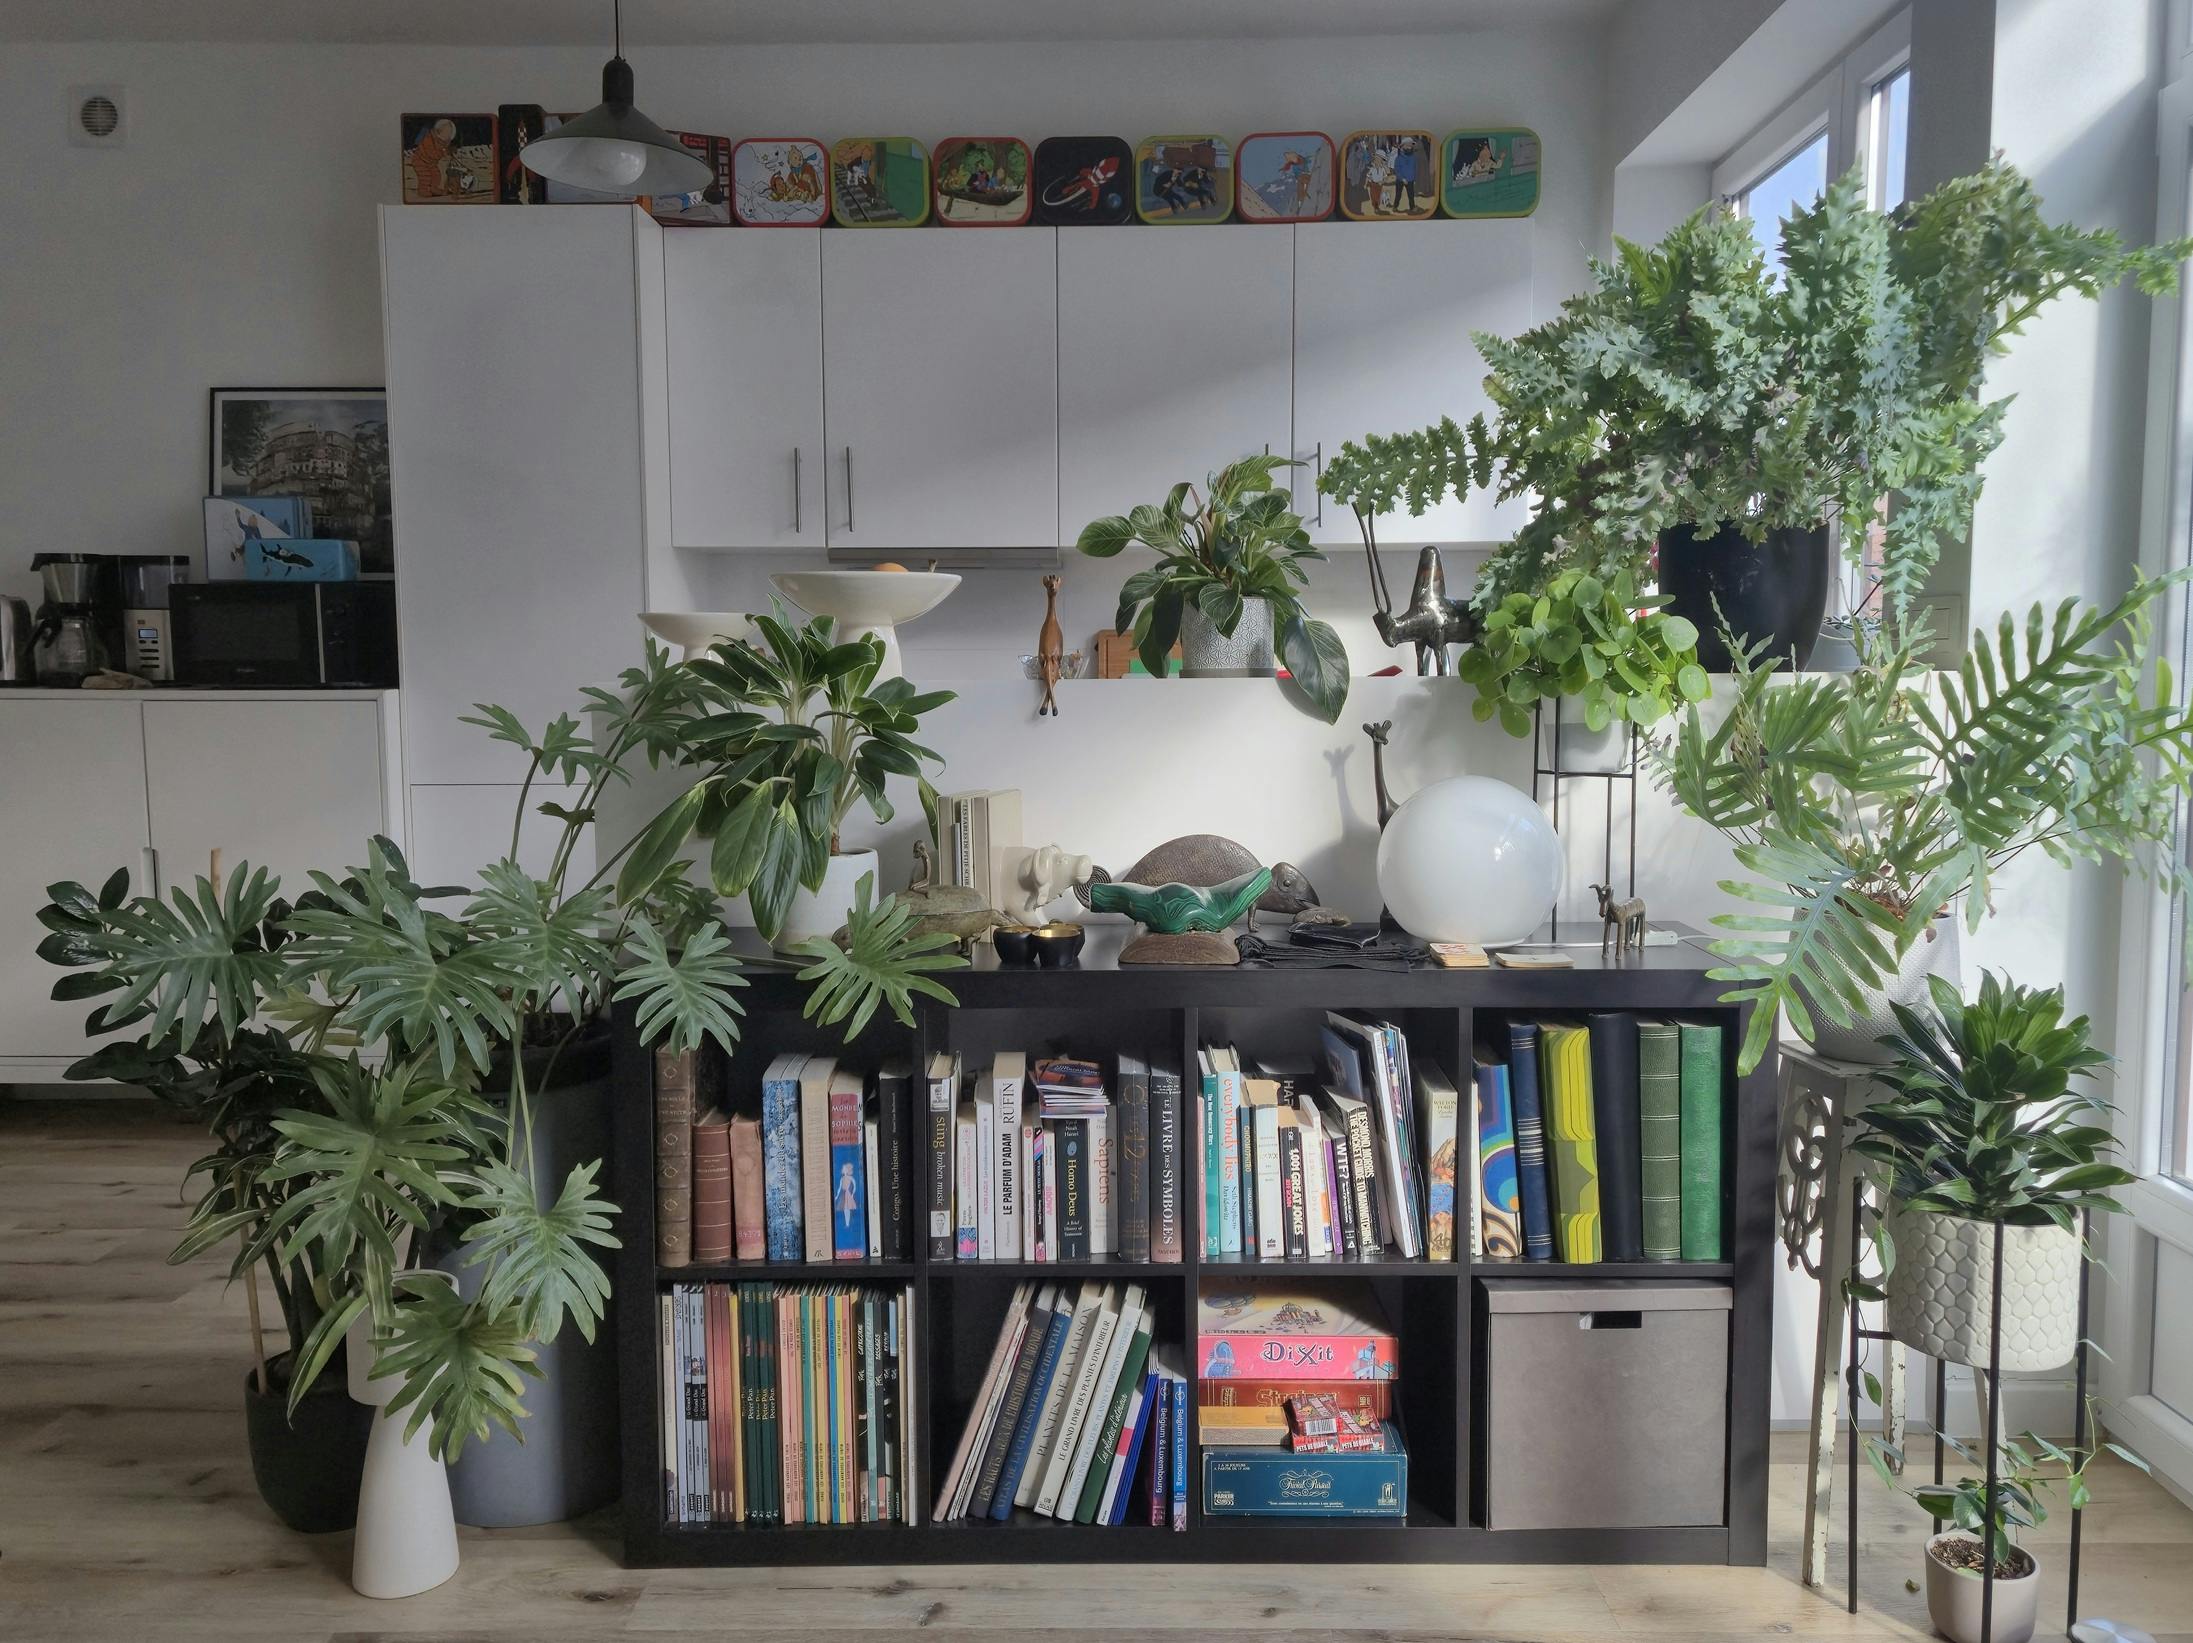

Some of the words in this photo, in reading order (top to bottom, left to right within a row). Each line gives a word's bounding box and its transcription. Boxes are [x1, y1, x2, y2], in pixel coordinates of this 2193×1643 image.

[1003, 1082, 1015, 1124] RUFIN
[1164, 1098, 1172, 1108] LE
[1221, 1078, 1239, 1151] everybody
[933, 1116, 945, 1149] sting
[1162, 1109, 1173, 1154] LIVRE
[1350, 1113, 1358, 1129] THE
[1358, 1111, 1371, 1148] DESMOND
[890, 1140, 899, 1170] histoire
[1002, 1133, 1012, 1166] D'ADAM
[1351, 1129, 1363, 1158] POCKET
[936, 1151, 944, 1180] broken
[1067, 1160, 1076, 1190] Homo
[1094, 1137, 1113, 1205] Sapiens
[1224, 1155, 1239, 1180] lies
[1337, 1142, 1349, 1180] WTF?
[1354, 1159, 1365, 1182] GUIDE
[1363, 1148, 1374, 1178] MORRIS
[891, 1172, 900, 1190] Une
[936, 1181, 944, 1206] music
[1002, 1169, 1013, 1203] PARFUM
[1291, 1172, 1302, 1205] GREAT
[1357, 1182, 1366, 1192] TO
[892, 1192, 901, 1222] Congo.
[1003, 1205, 1013, 1215] LE
[1068, 1192, 1077, 1217] Deus
[1163, 1169, 1173, 1245] SYMBOLES
[1357, 1192, 1372, 1245] MANWATCHING
[1293, 1204, 1304, 1236] JOKES
[1025, 1328, 1044, 1358] MONDE
[1068, 1307, 1092, 1356] MAISON
[1092, 1320, 1111, 1363] D'INTÉRIEUR
[1036, 1320, 1063, 1387] OCCIDENTALE
[1063, 1361, 1076, 1379] LA
[1081, 1363, 1096, 1392] PLANTES
[1056, 1379, 1068, 1399] DE
[1078, 1392, 1086, 1407] DES
[1070, 1407, 1082, 1430] LIVRE
[1107, 1390, 1129, 1428] d'intérieur
[1159, 1408, 1168, 1438] Belgium
[1037, 1401, 1062, 1457] PLANTES
[1063, 1428, 1075, 1453] GRAND
[1098, 1425, 1119, 1454] plantes
[1358, 1438, 1374, 1446] DIABLE
[986, 1456, 1001, 1483] HAUTS
[1058, 1450, 1066, 1461] LE
[1095, 1449, 1109, 1464] Les
[1155, 1447, 1167, 1494] Luxembourg
[980, 1479, 993, 1502] LES
[1279, 1477, 1305, 1490] Trivial
[1303, 1477, 1332, 1490] Pursuit
